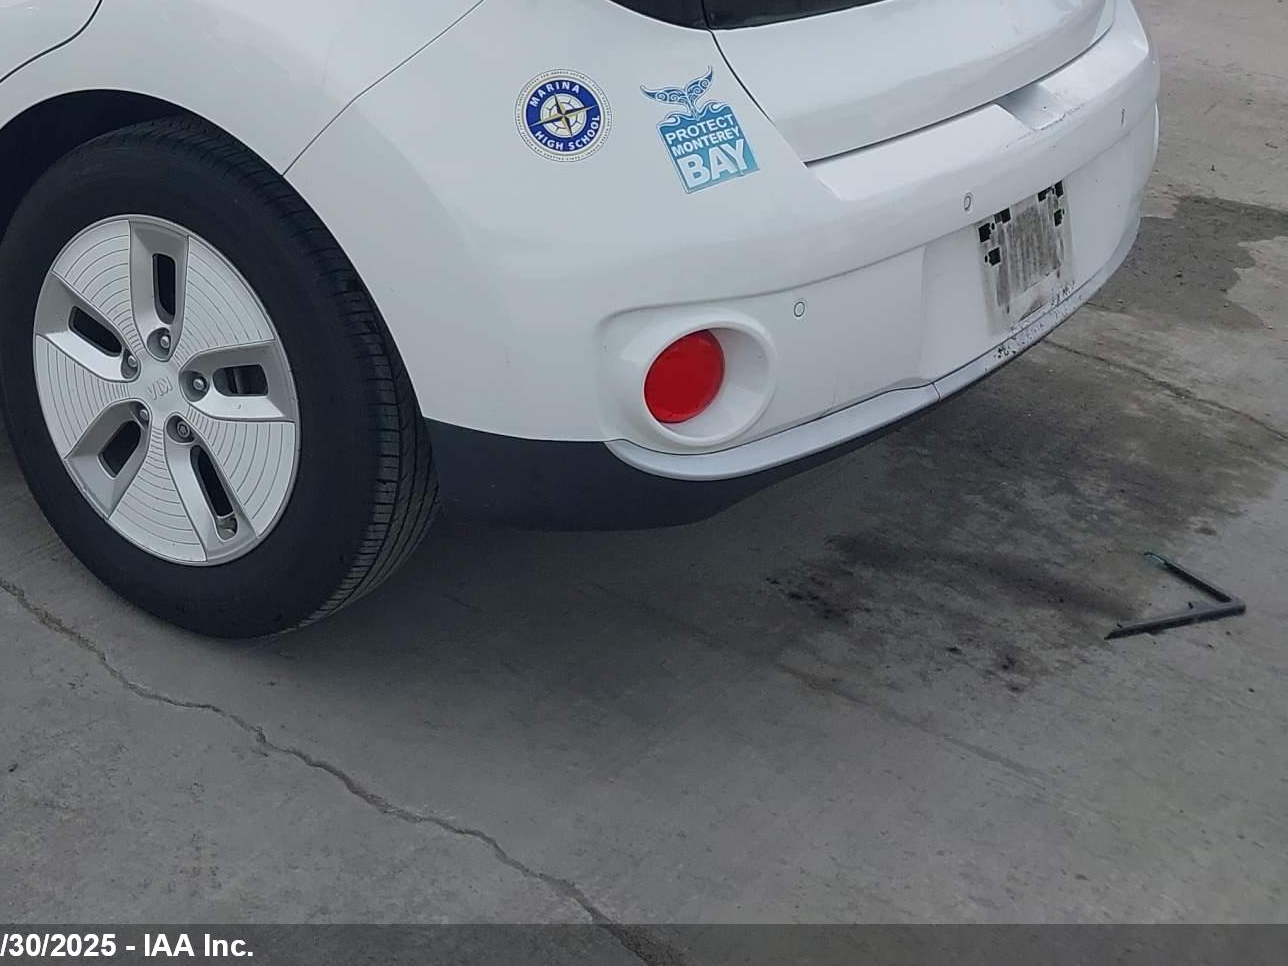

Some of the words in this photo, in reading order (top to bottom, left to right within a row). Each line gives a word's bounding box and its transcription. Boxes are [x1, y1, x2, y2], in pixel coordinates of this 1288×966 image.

[529, 81, 580, 107] MARINA
[534, 130, 564, 151] HIGH
[568, 114, 600, 151] SCHOOL
[665, 114, 735, 145] PROTECT
[671, 125, 740, 157] MONTEREY
[676, 138, 748, 189] BAY
